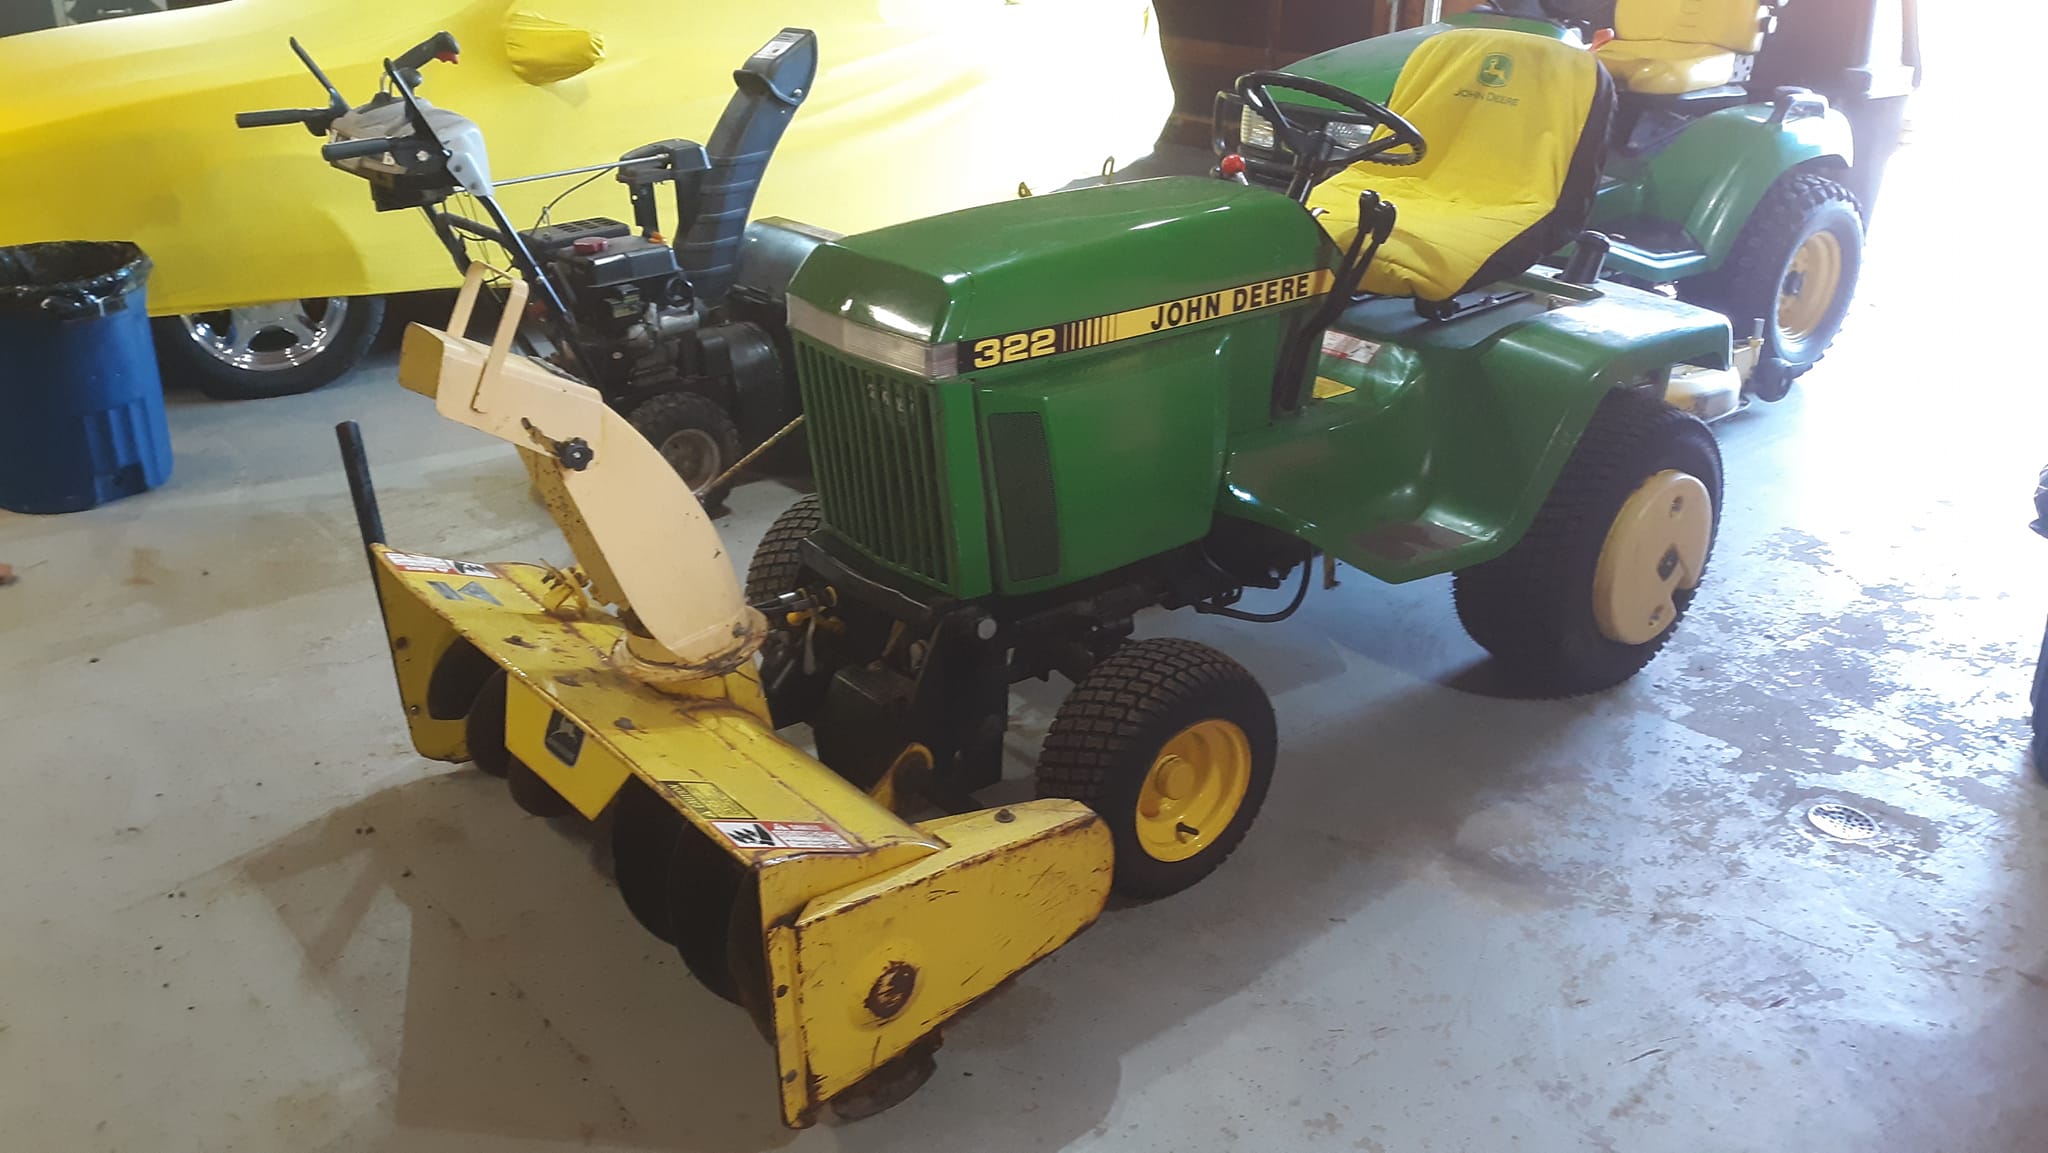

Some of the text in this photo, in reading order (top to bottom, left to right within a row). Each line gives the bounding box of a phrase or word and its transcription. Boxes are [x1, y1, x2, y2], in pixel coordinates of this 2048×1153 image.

[1151, 275, 1309, 331] JOHN DEERE
[974, 328, 1056, 369] 322
